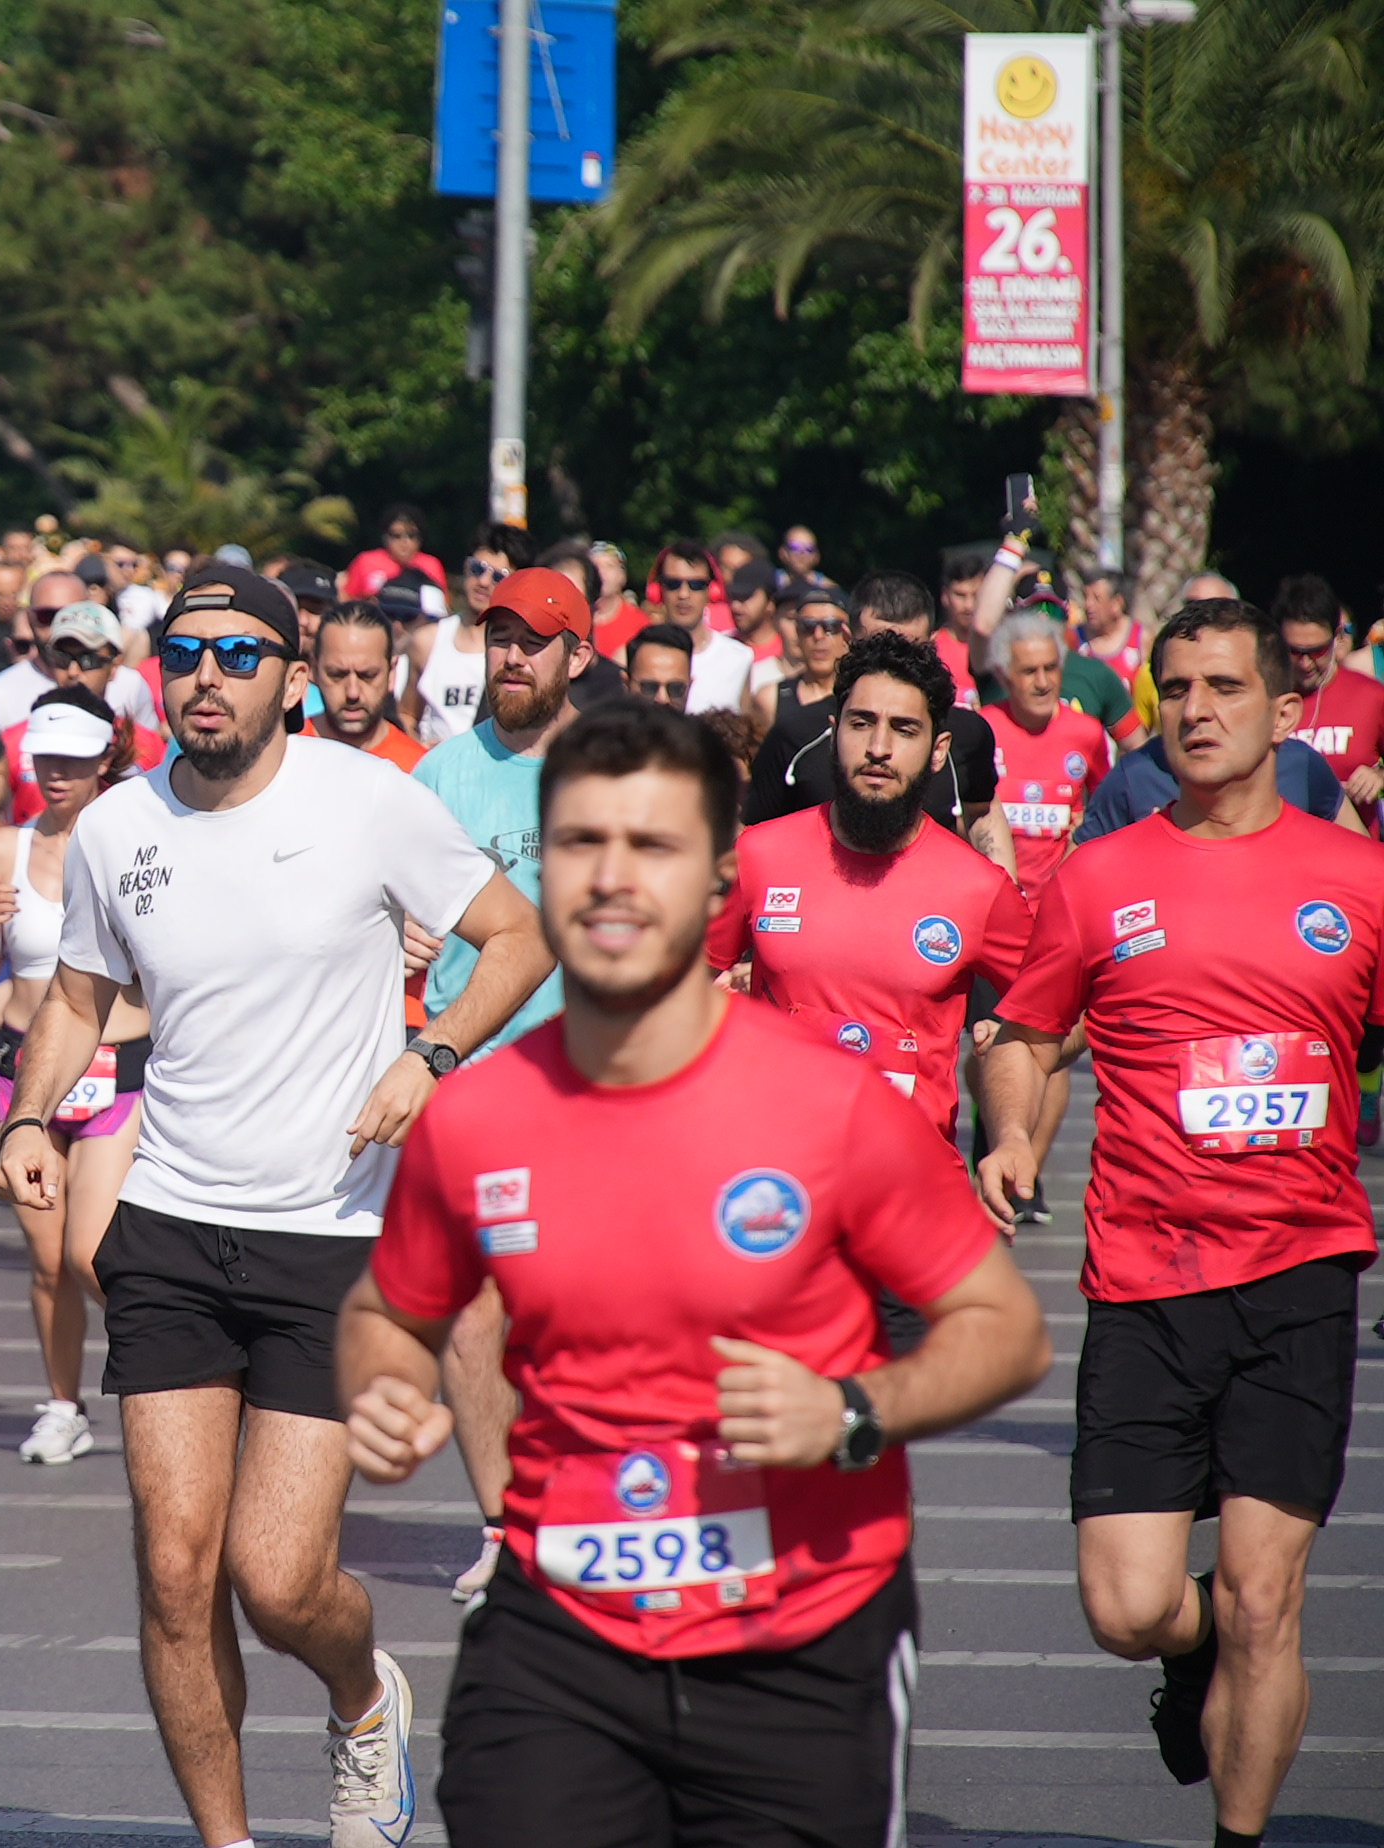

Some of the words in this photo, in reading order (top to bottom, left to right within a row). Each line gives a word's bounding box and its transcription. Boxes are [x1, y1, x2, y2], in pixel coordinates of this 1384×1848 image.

[978, 117, 1073, 150] Happy
[978, 149, 1071, 175] Center
[978, 206, 1074, 273] 26.
[1008, 806, 1059, 824] 2886
[133, 844, 159, 867] NO
[118, 866, 174, 898] REASON
[134, 893, 155, 917] CO.
[1207, 1090, 1310, 1128] 2957
[575, 1522, 732, 1583] 2598
